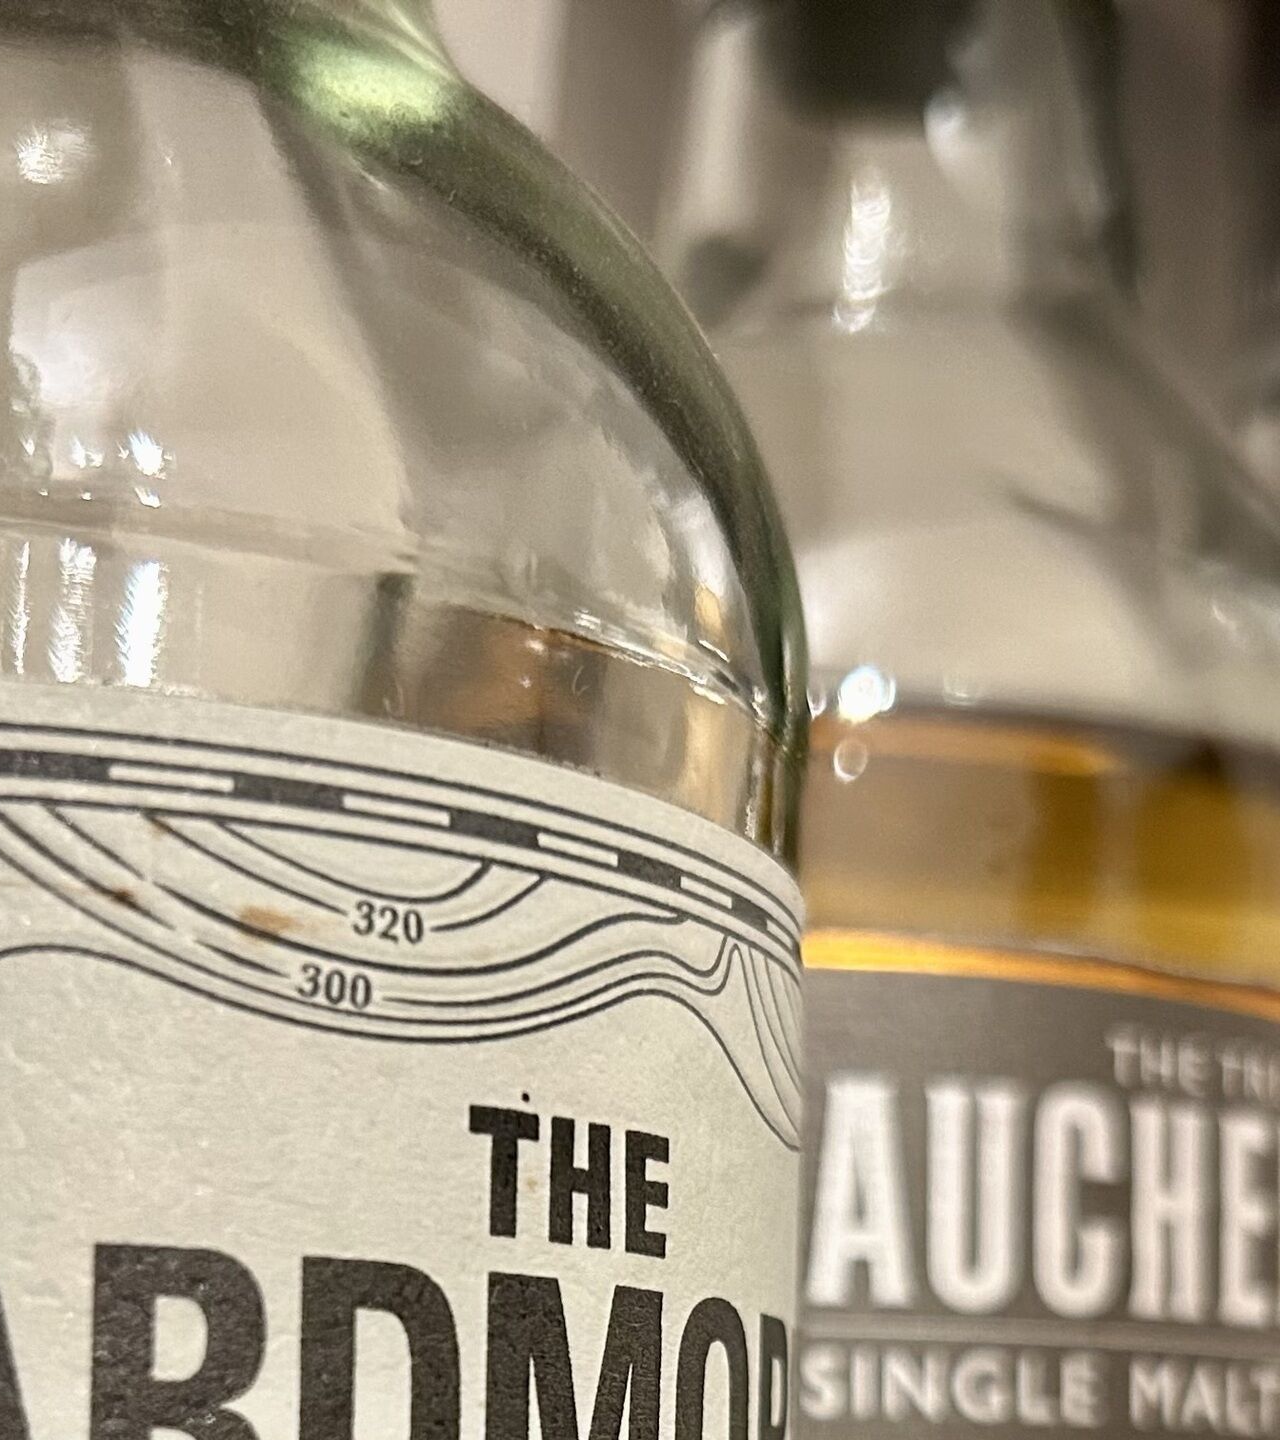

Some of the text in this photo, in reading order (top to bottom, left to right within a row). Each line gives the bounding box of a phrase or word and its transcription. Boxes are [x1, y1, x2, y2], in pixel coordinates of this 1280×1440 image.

[353, 901, 423, 944] 320
[297, 963, 372, 1010] 300
[468, 1103, 670, 1259] THE
[798, 1345, 1107, 1430] SINGLE
